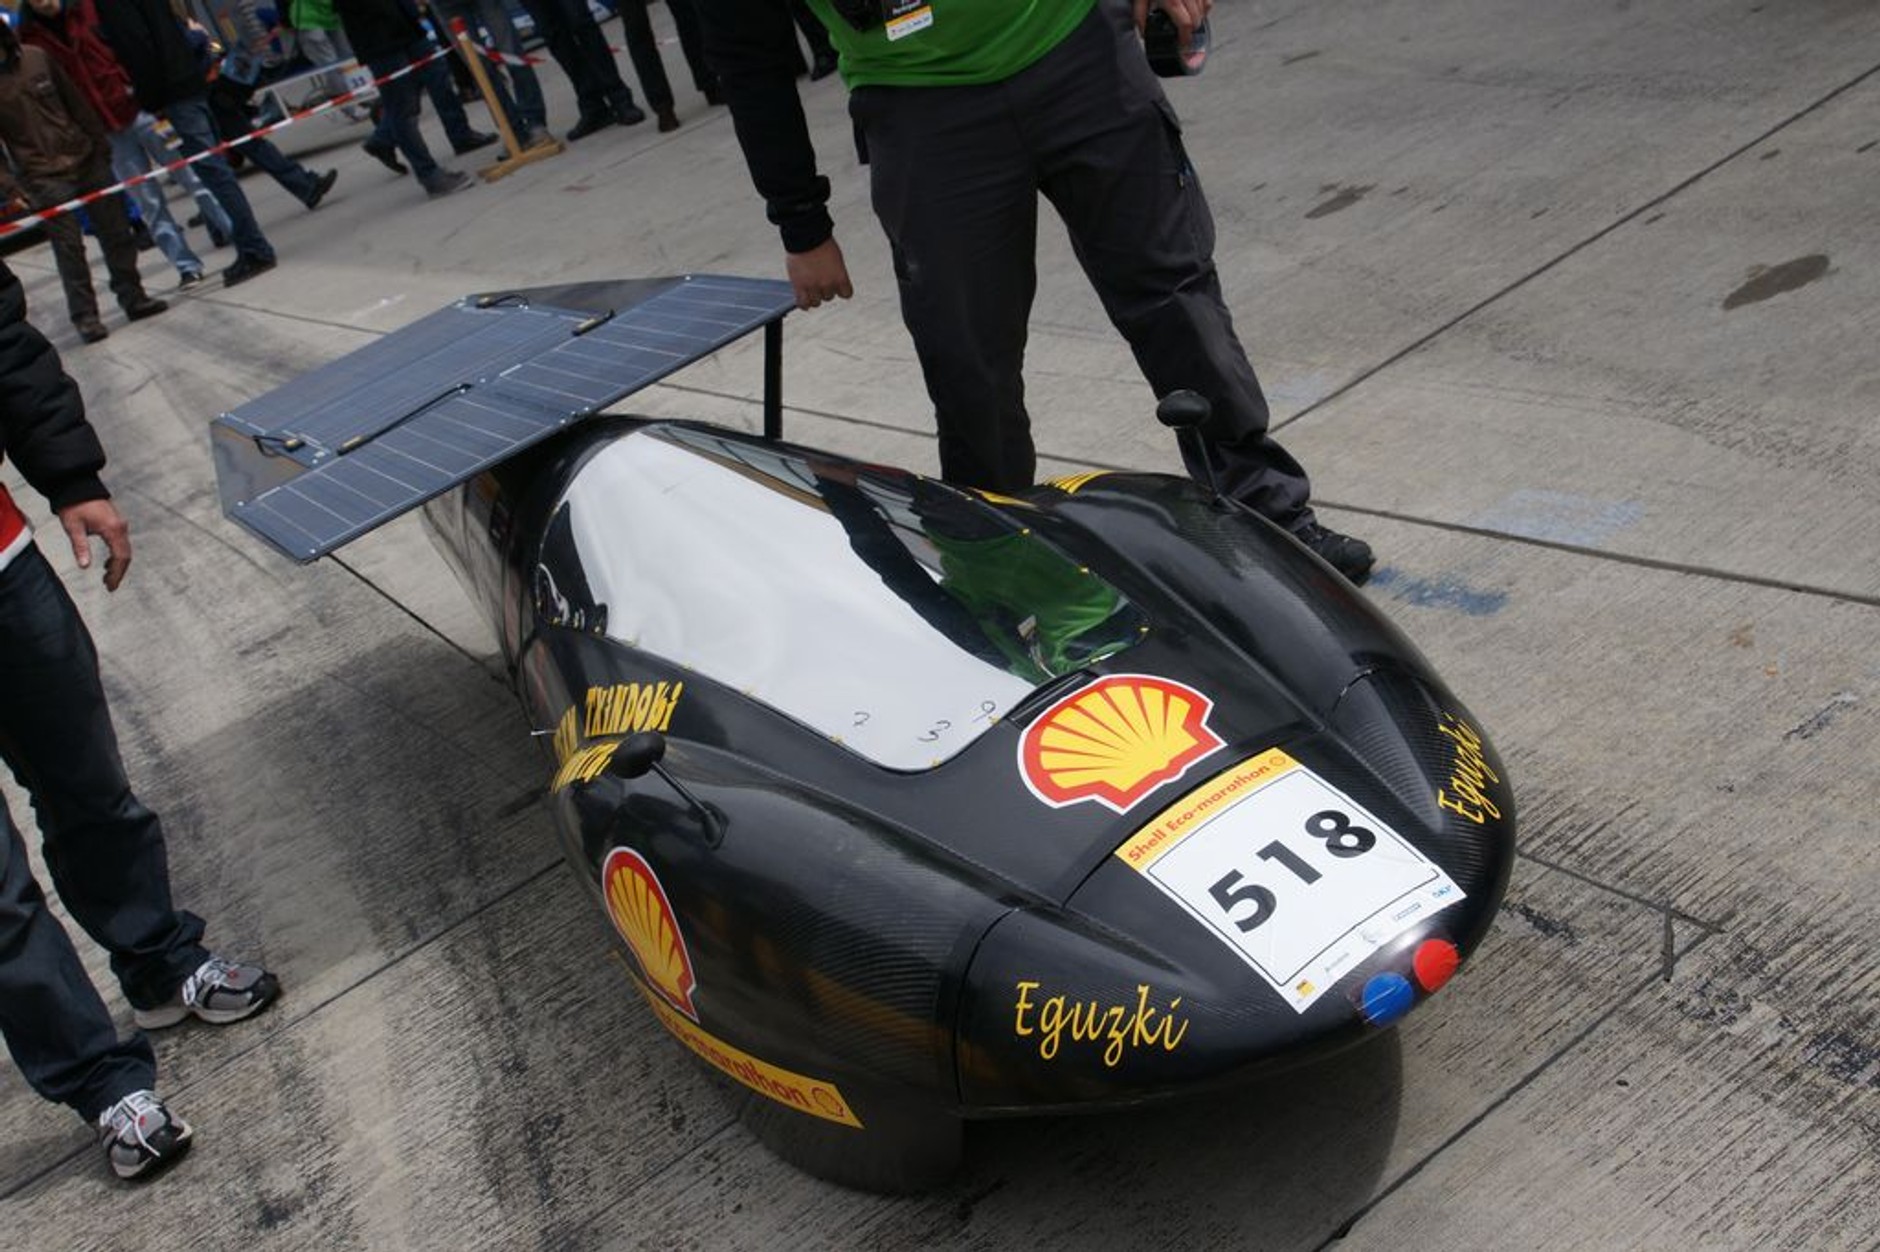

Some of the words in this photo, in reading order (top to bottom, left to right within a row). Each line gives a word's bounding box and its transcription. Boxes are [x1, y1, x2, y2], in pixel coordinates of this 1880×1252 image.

[1128, 828, 1167, 862] Shell
[1165, 764, 1271, 832] Eco-marathon
[1438, 711, 1501, 824] Eguzki
[1208, 809, 1377, 933] 518
[1015, 981, 1189, 1067] Eguzki
